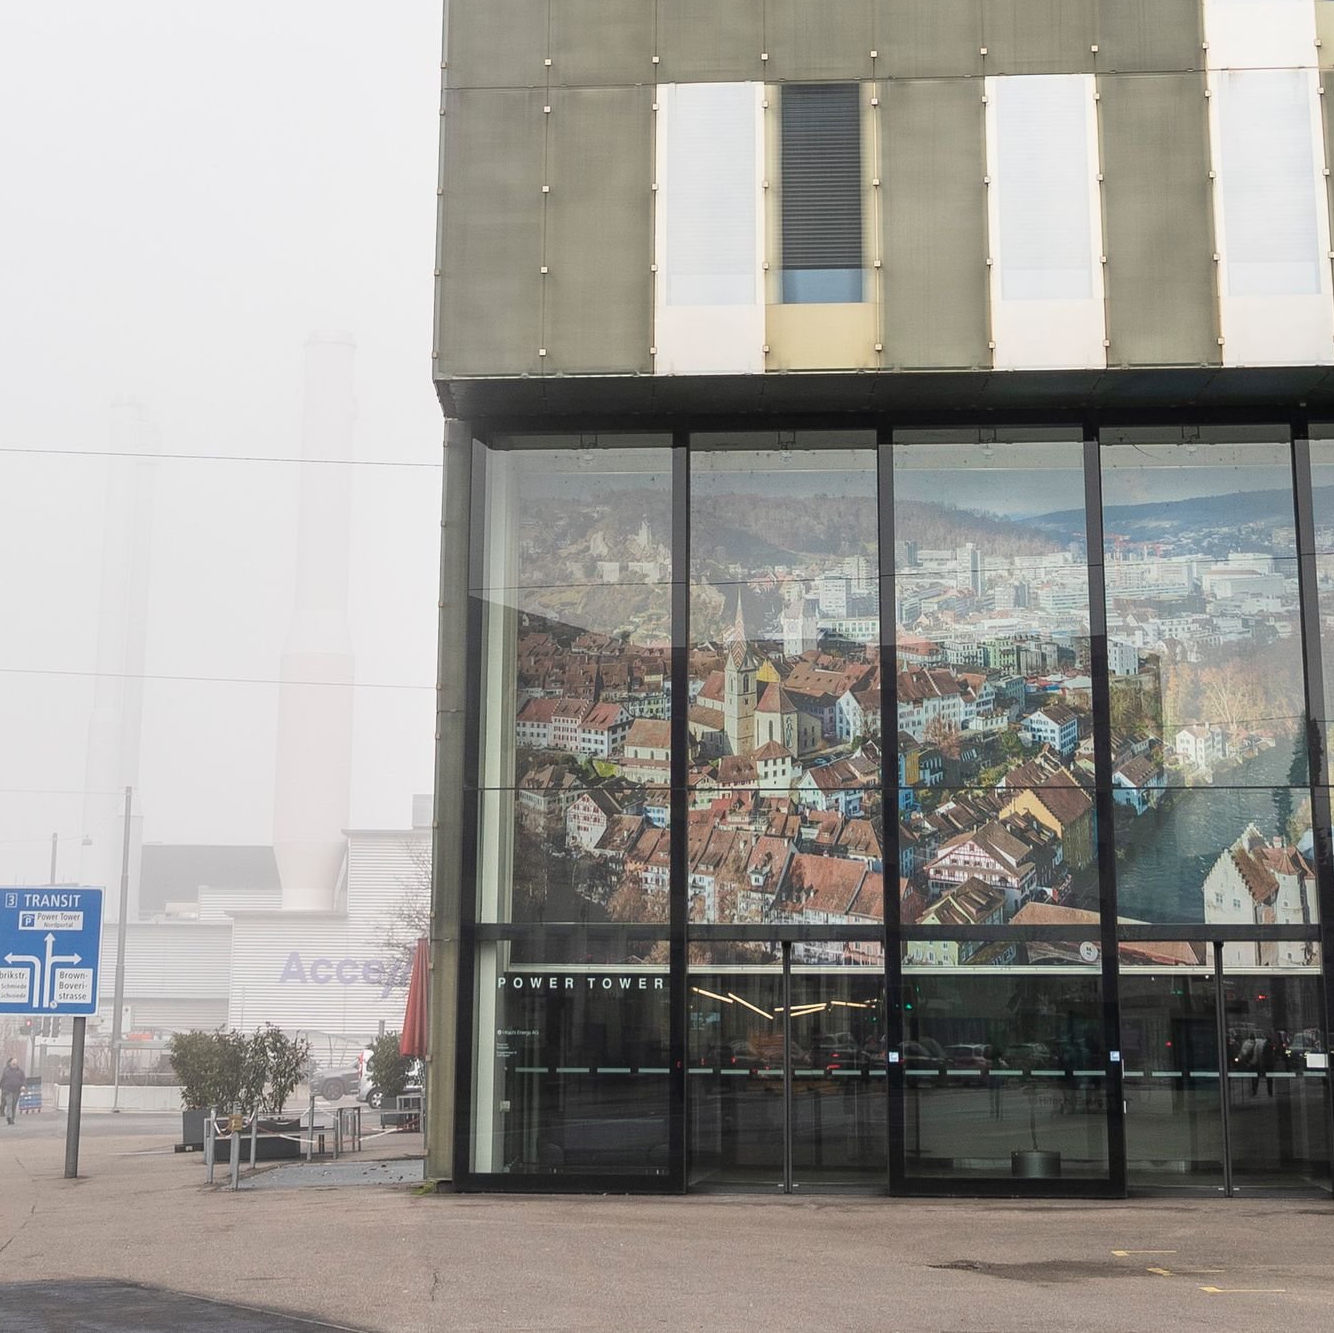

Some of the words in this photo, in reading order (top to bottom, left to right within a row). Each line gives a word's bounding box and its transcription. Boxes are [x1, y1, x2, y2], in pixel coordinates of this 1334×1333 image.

[24, 894, 81, 907] TRANSIT
[37, 912, 58, 921] Power
[60, 912, 81, 921] Tower
[59, 971, 89, 979] Brown-
[58, 981, 88, 990] Boveri-
[497, 977, 574, 989] POWER
[587, 977, 664, 990] TOWER
[58, 993, 87, 1001] strasse
